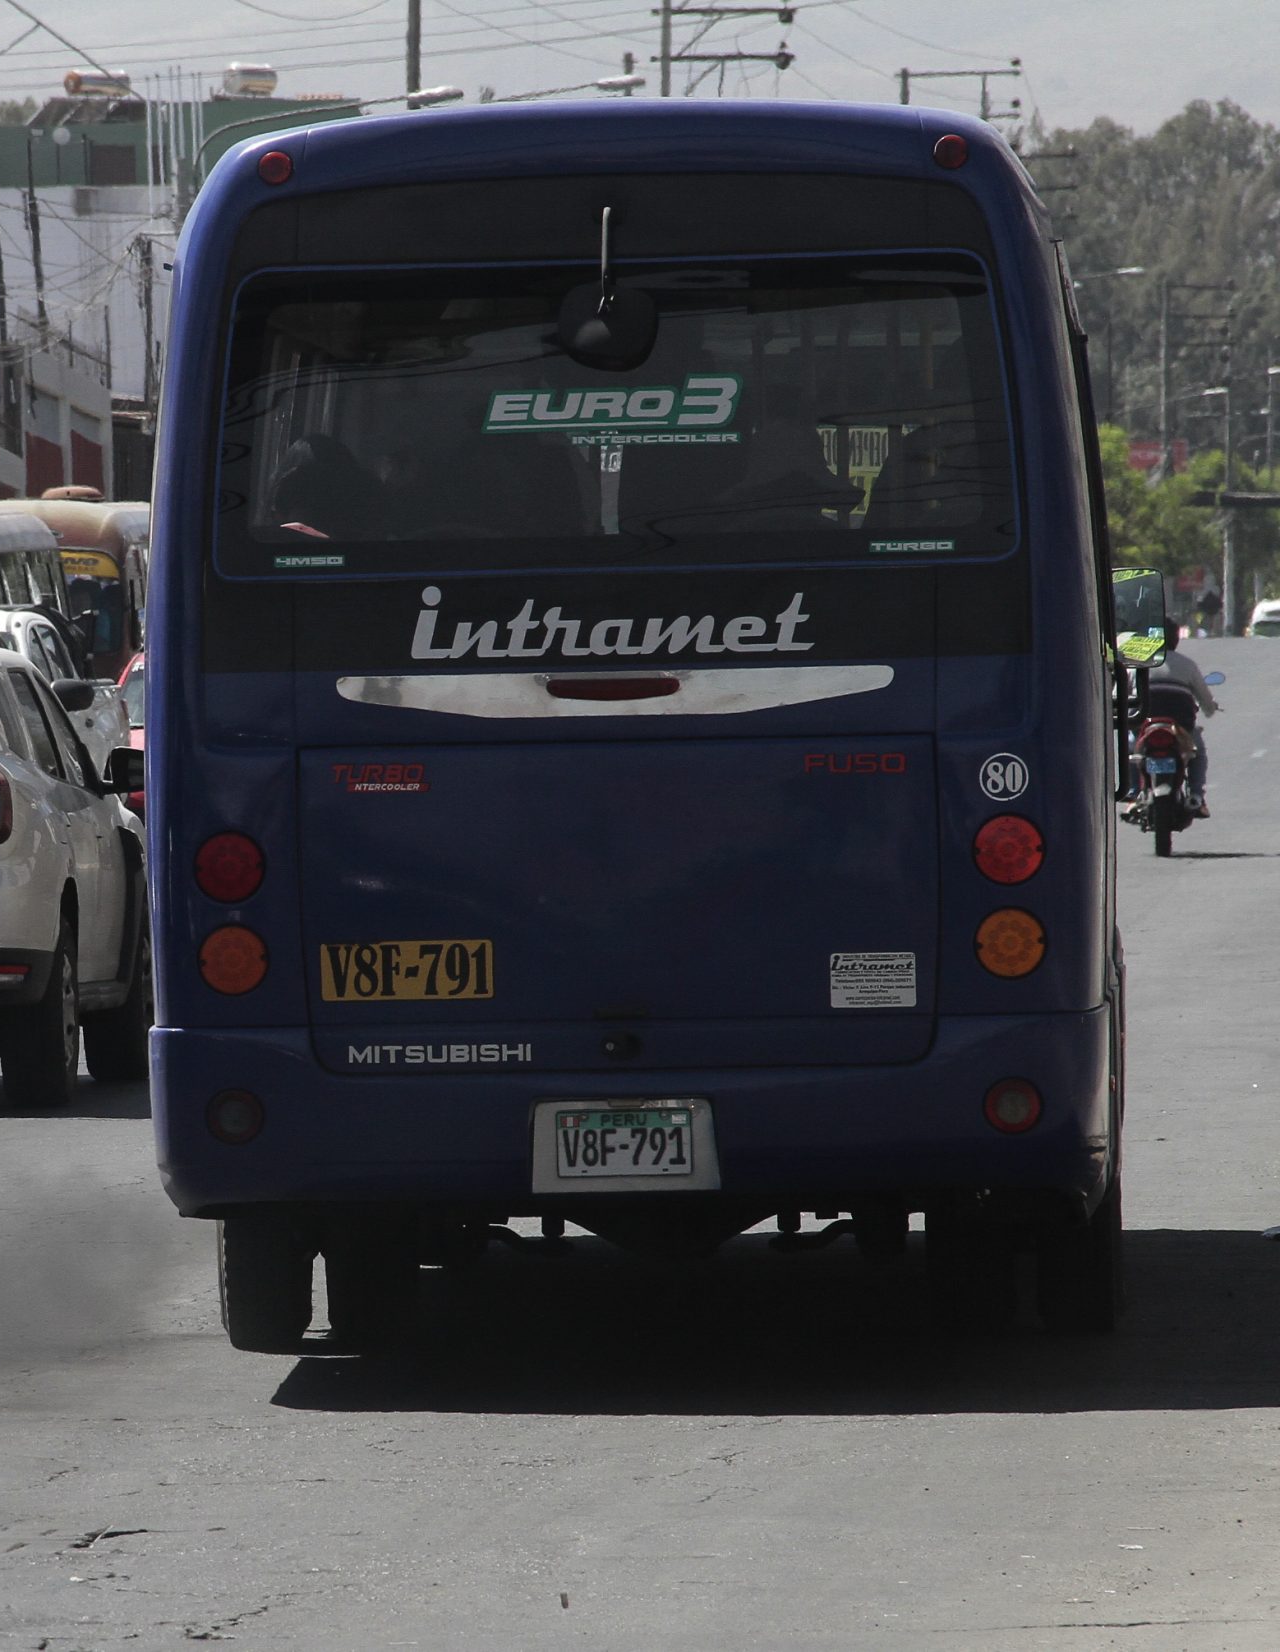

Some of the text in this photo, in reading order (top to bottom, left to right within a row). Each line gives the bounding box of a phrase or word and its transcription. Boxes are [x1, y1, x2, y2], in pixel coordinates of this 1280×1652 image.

[572, 433, 739, 444] INTERCOOLER
[872, 541, 954, 551] TURBO
[330, 763, 425, 784] TURBO
[804, 753, 907, 774] FUSO
[985, 760, 1023, 794] 80
[327, 942, 490, 998] V8F-791
[349, 1043, 532, 1064] MITSUBISHI
[601, 1113, 648, 1127] PERU
[562, 1127, 687, 1168] V8F-791
